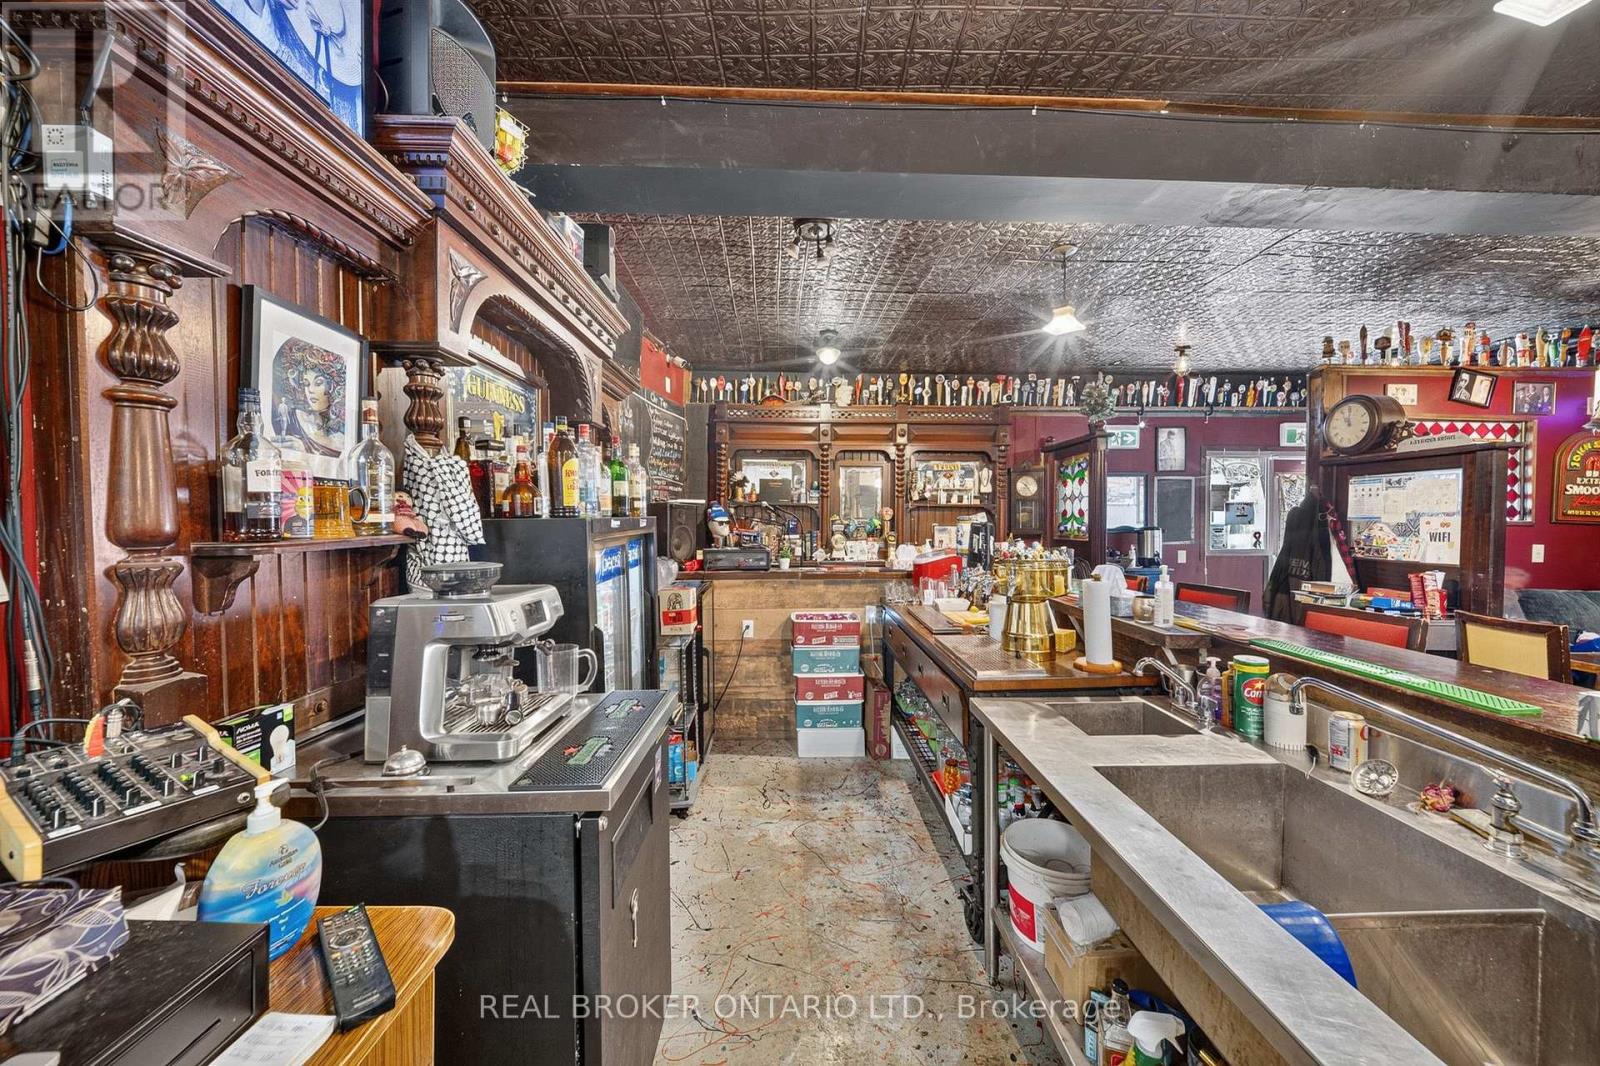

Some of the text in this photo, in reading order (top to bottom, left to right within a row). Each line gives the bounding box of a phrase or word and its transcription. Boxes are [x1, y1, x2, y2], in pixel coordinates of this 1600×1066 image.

[466, 373, 525, 414] GUINNESS
[1565, 484, 1600, 495] SMOO
[1428, 531, 1451, 543] WIFI
[236, 721, 260, 735] NOMA
